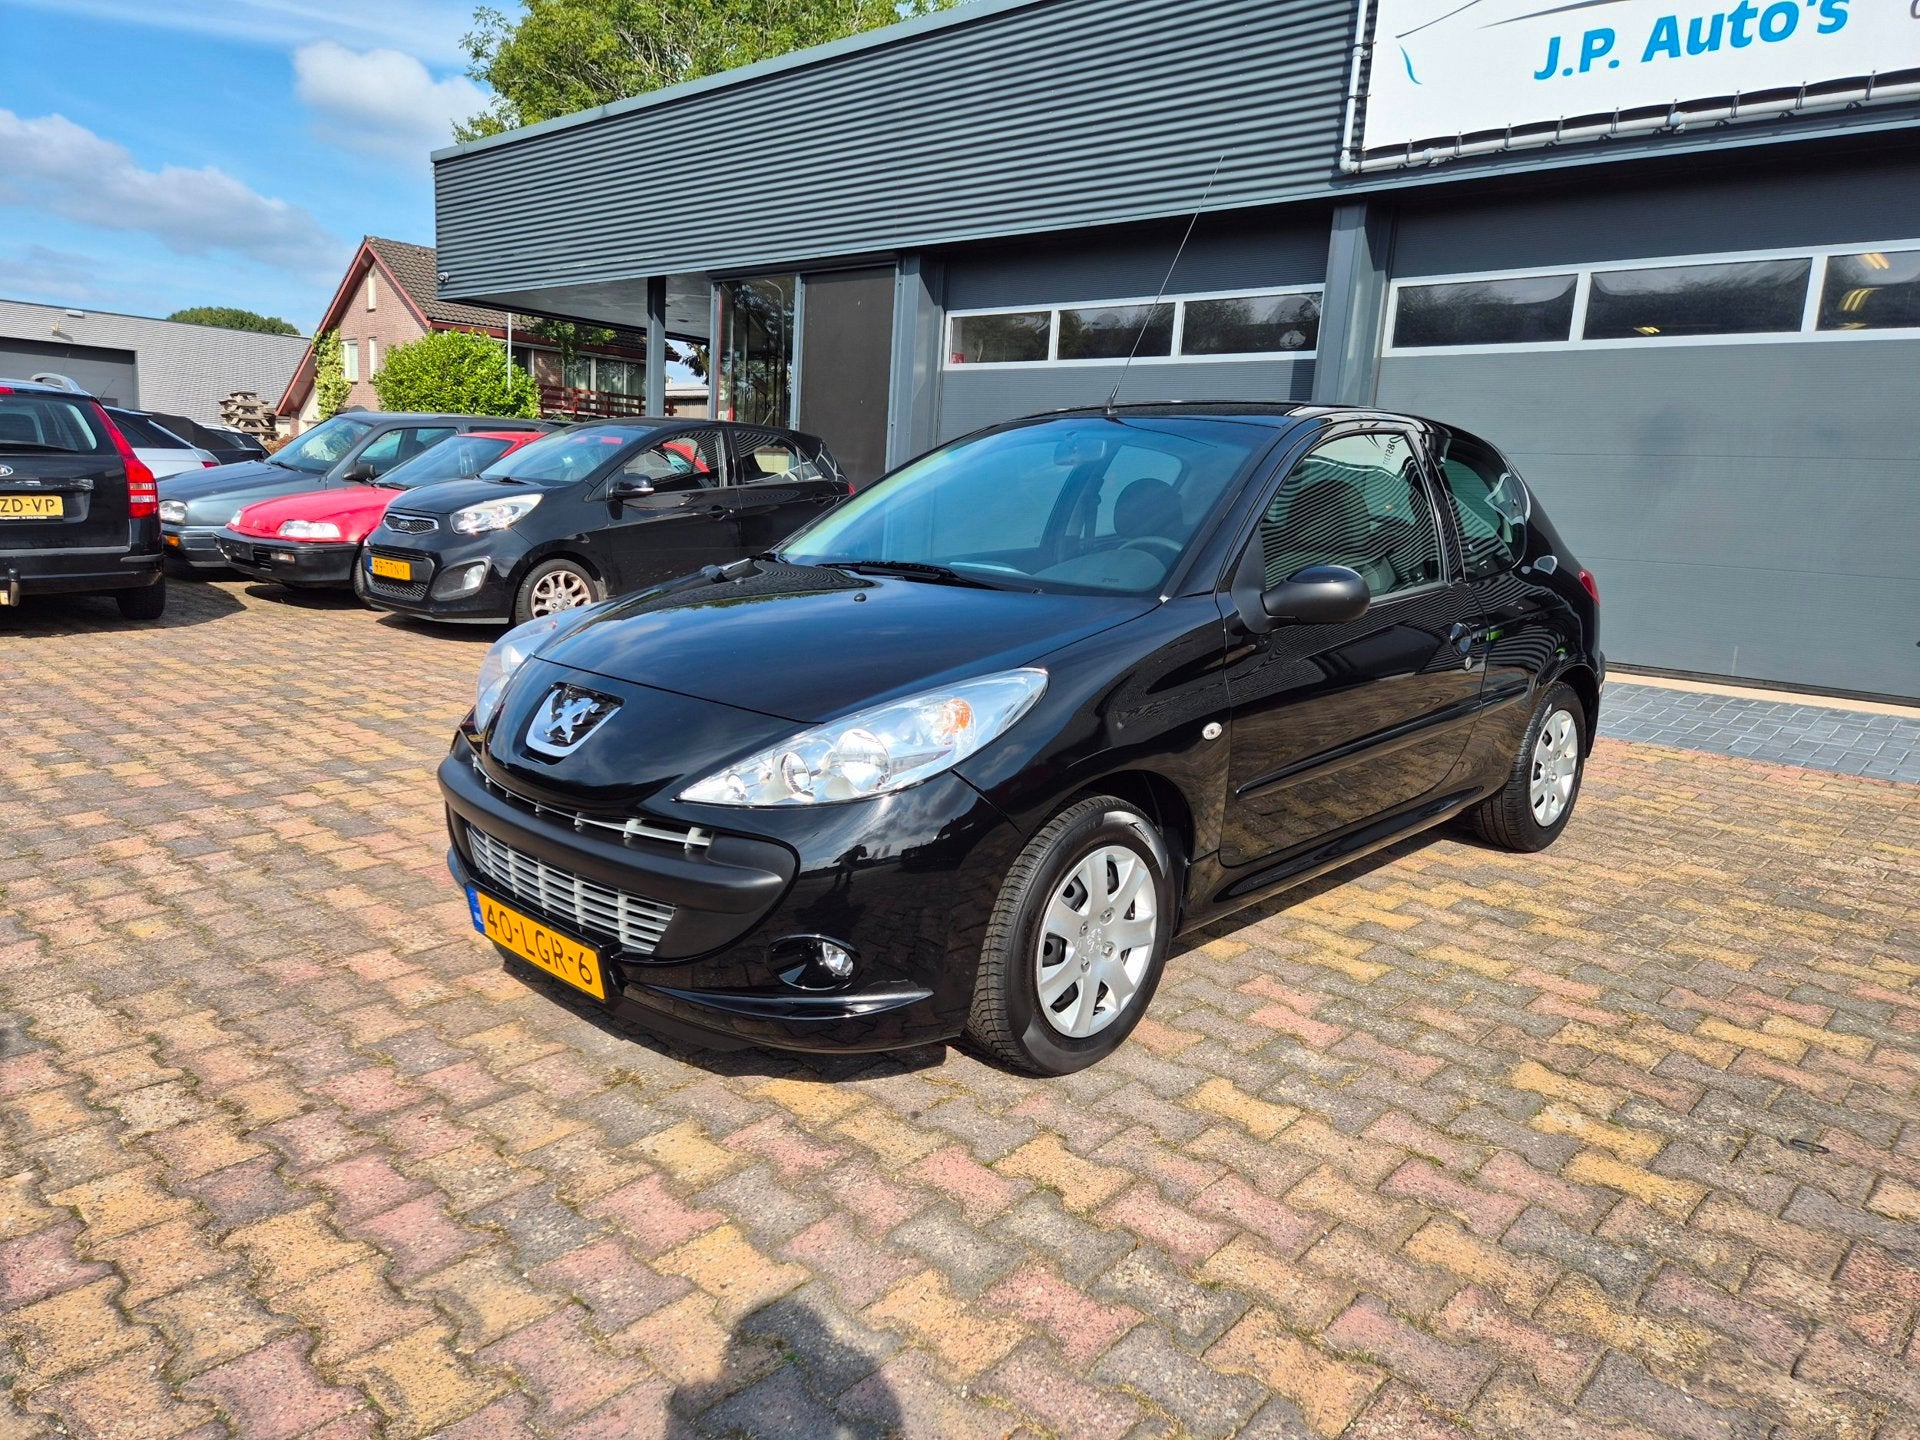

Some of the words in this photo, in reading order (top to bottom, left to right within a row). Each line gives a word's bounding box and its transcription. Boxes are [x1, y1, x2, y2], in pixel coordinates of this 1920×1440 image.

[1534, 27, 1620, 80] J.P.
[0, 498, 55, 513] ZD-VP
[487, 904, 593, 985] 40-LGR-6
